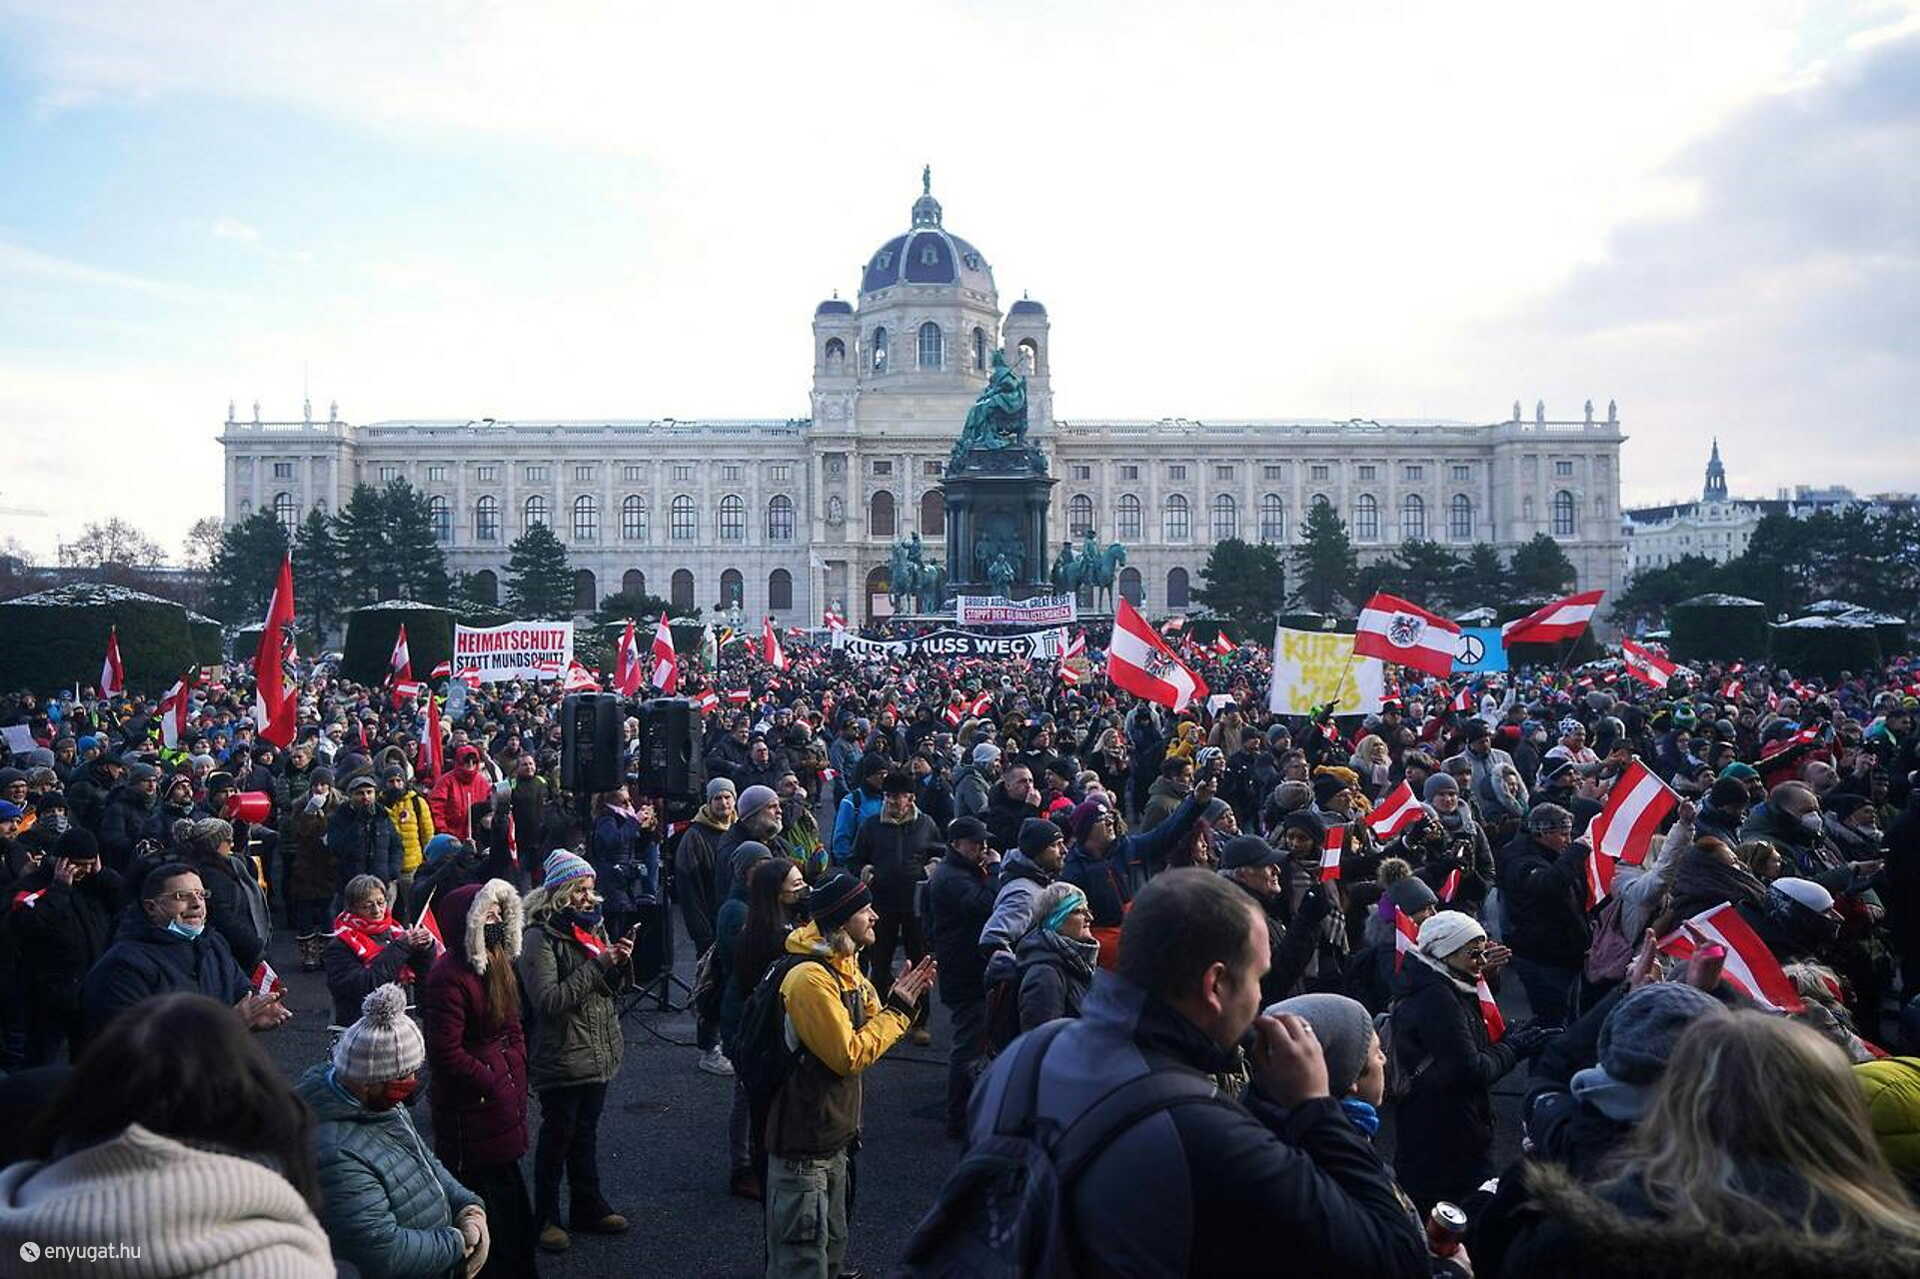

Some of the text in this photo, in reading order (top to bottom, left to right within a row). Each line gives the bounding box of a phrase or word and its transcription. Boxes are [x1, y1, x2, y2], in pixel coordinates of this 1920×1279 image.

[457, 630, 565, 653] HEIMATSCHUTZ
[974, 638, 1025, 654] WEG
[457, 654, 489, 670] STATT
